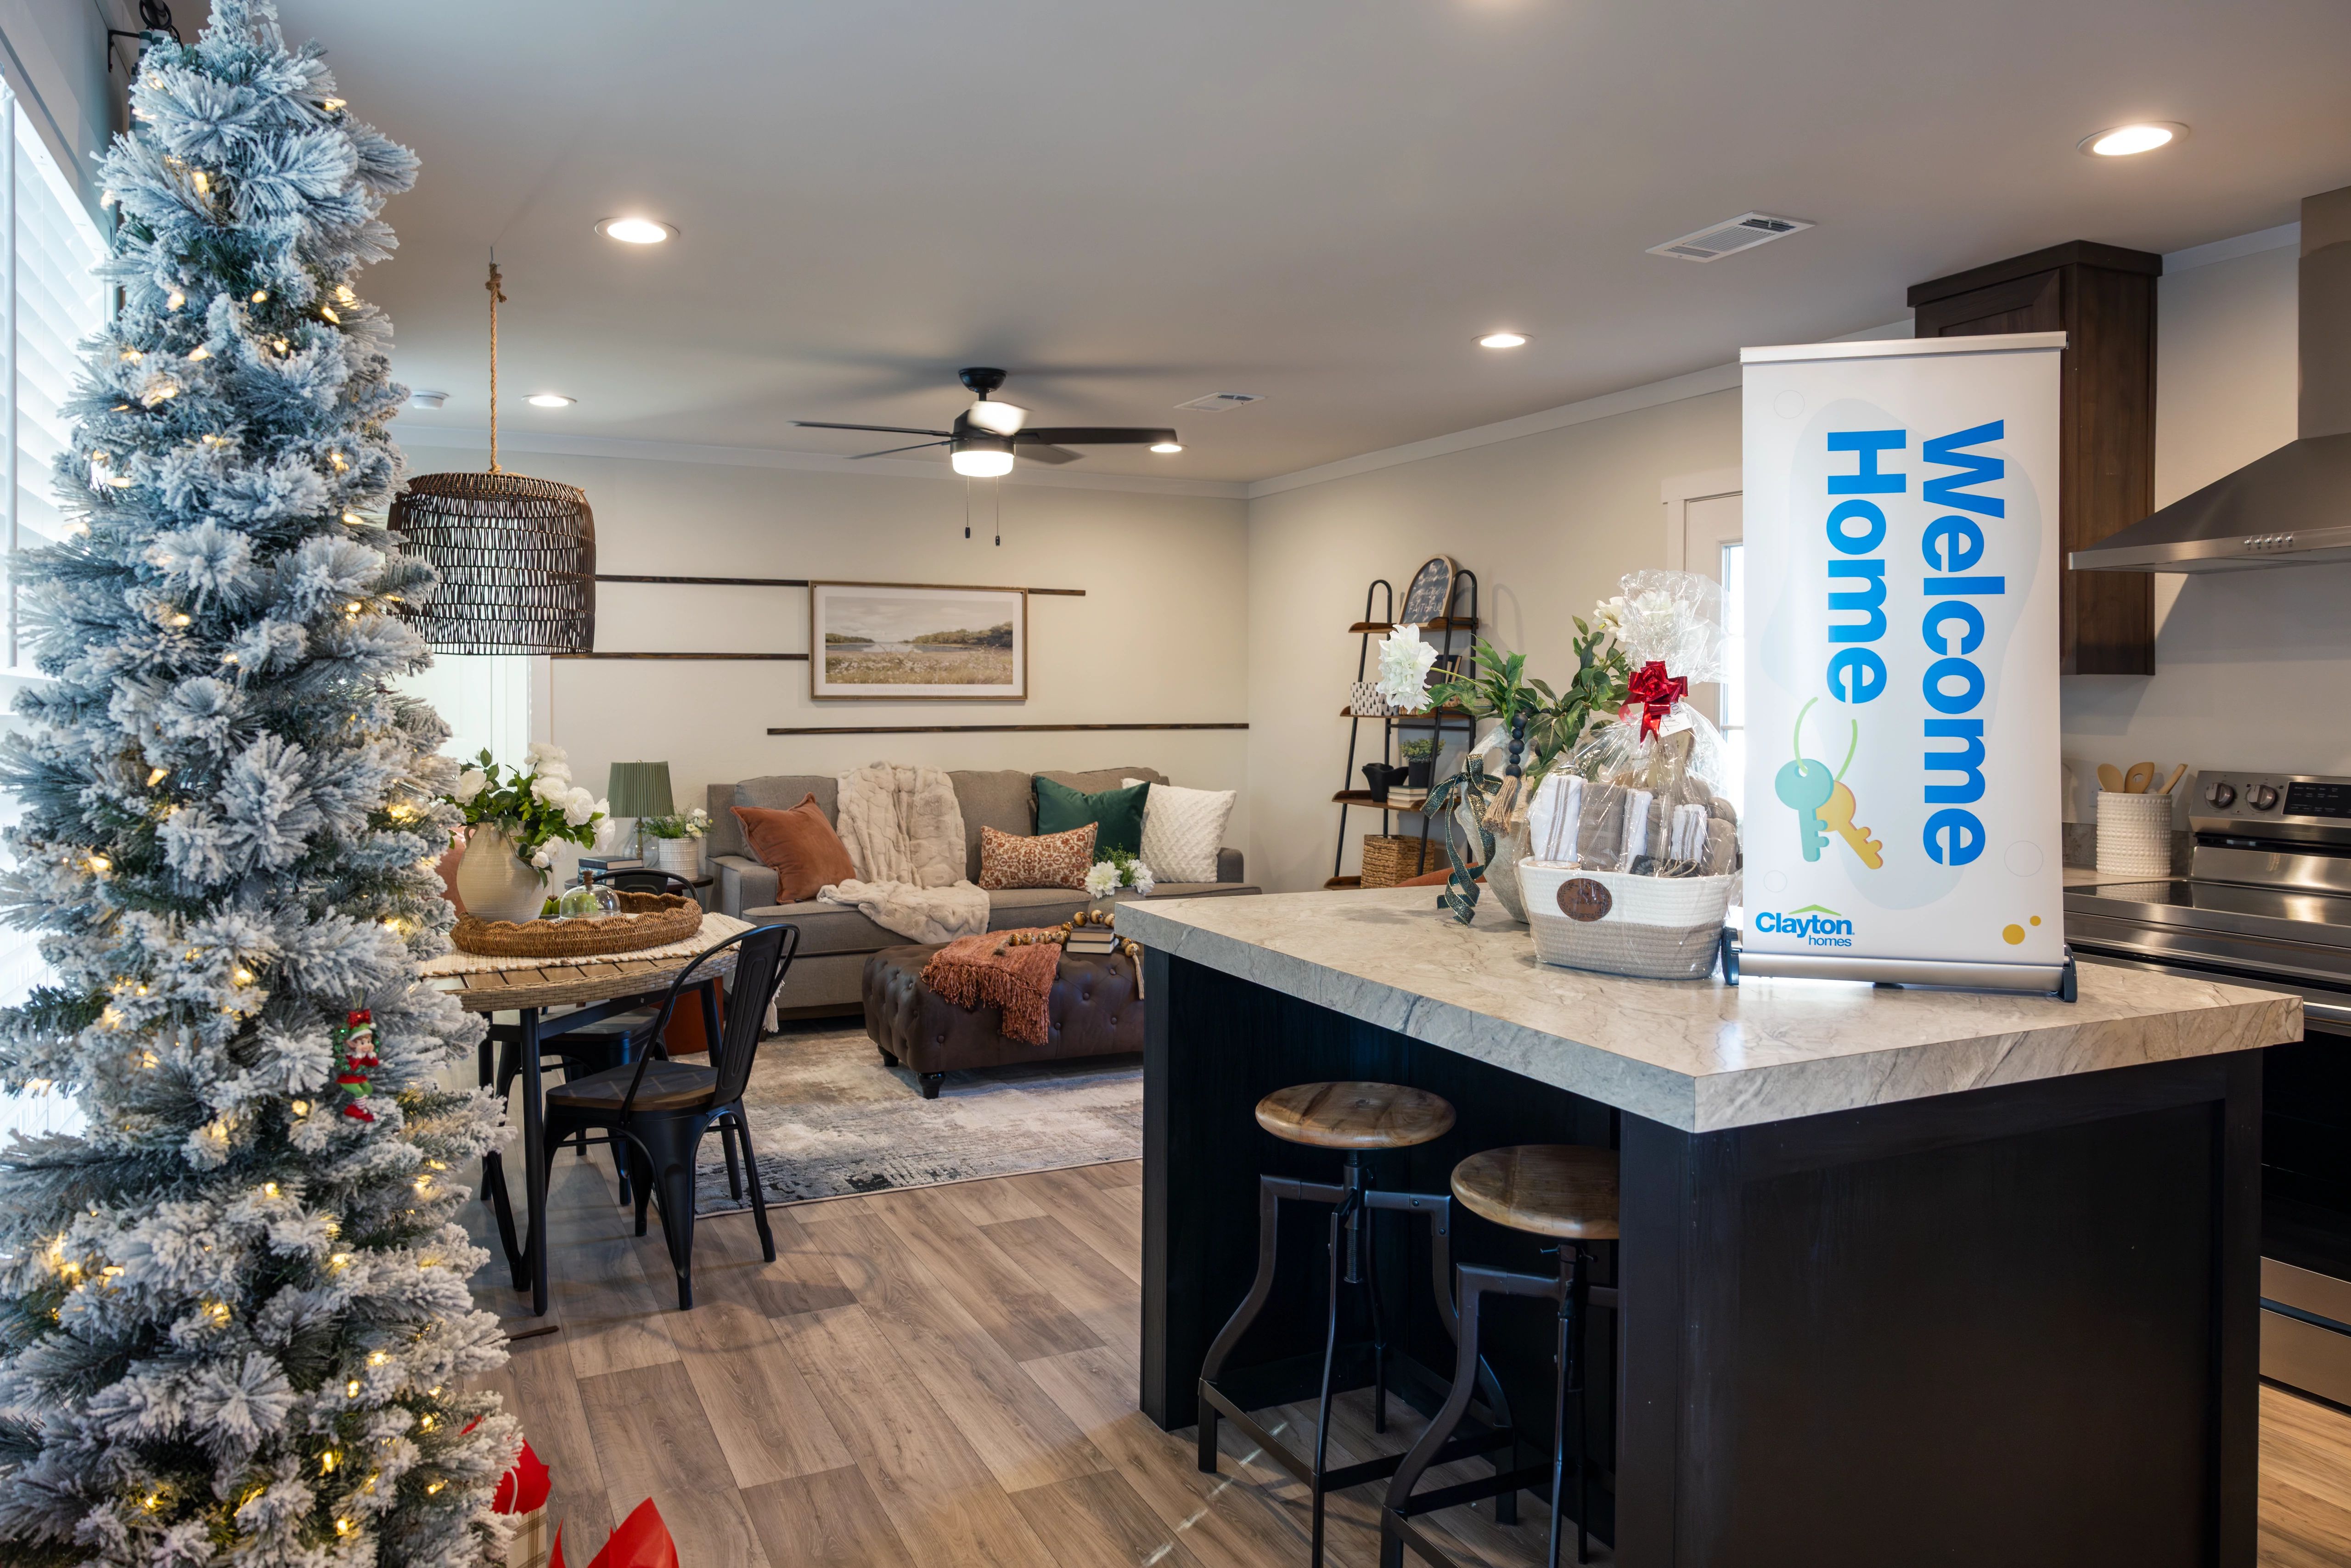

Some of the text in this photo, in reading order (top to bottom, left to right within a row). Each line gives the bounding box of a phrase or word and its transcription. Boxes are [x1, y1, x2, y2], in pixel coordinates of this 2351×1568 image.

[1827, 429, 1906, 704] Home
[1408, 602, 1442, 614] FAITHFUL
[1922, 419, 2005, 866] Welcome
[1755, 912, 1852, 938] Clayton
[1809, 935, 1852, 947] homes
